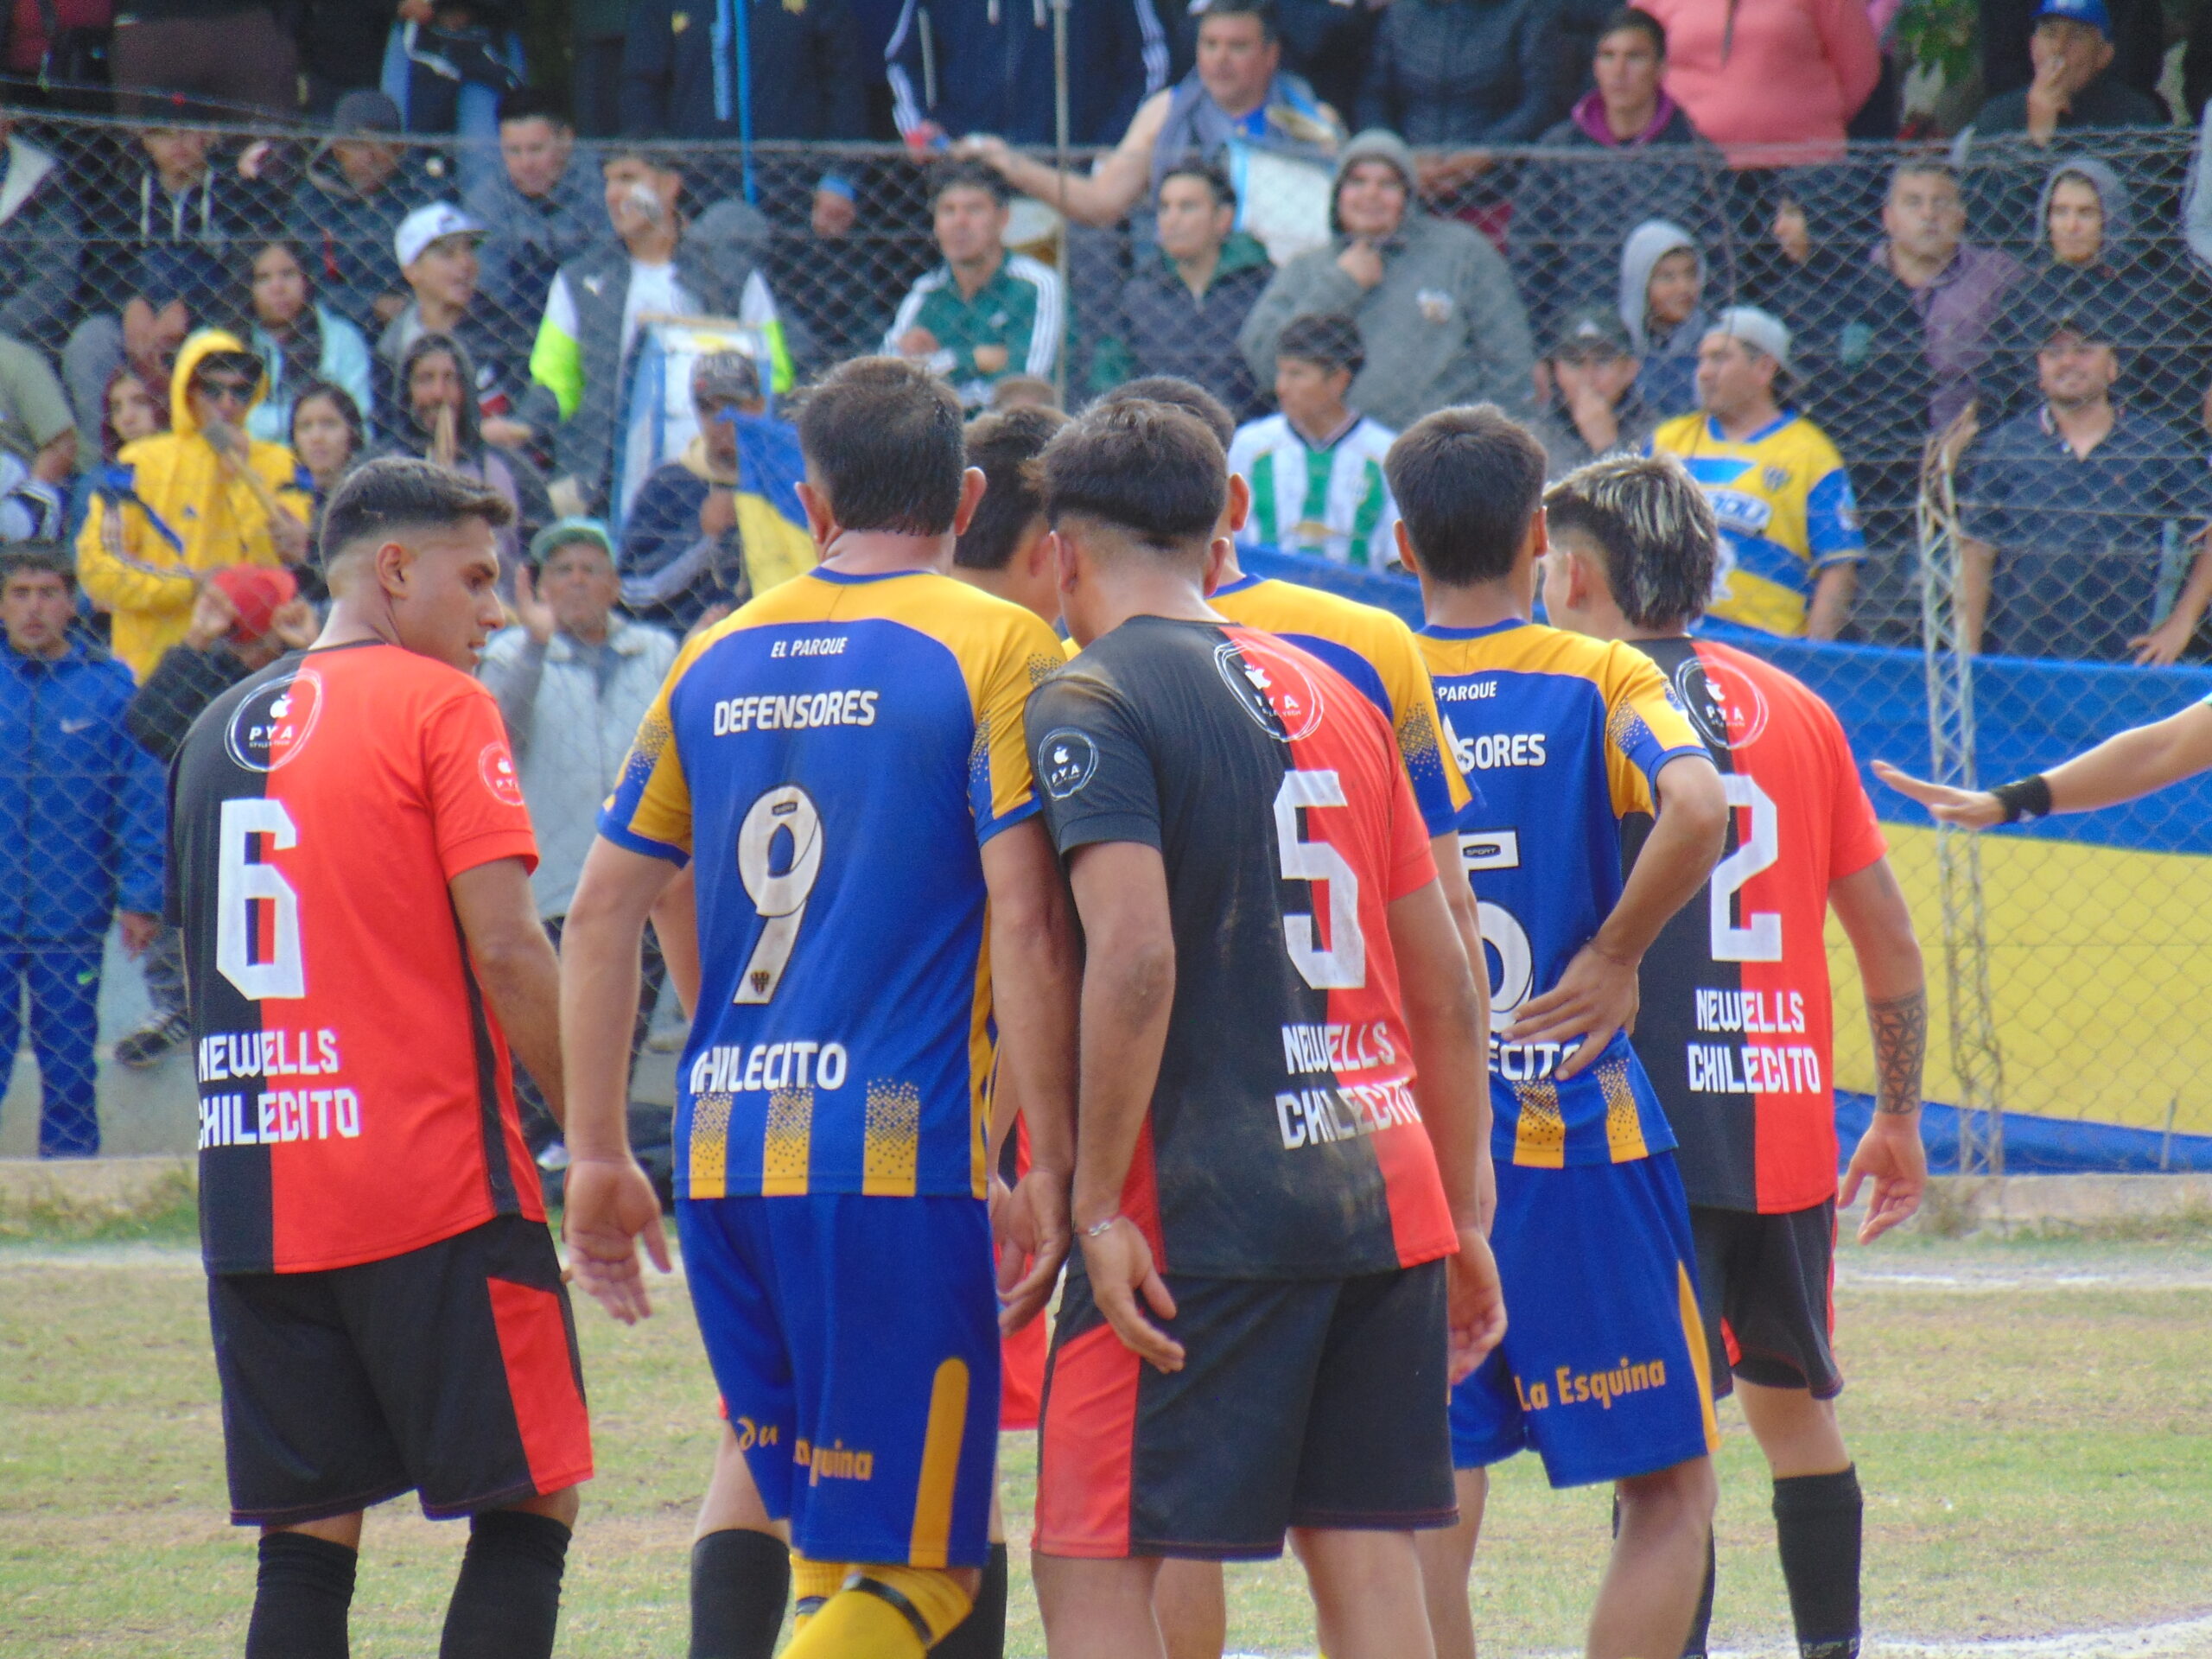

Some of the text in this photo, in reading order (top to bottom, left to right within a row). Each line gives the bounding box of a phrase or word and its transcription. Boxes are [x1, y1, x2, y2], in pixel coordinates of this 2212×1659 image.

[771, 637, 849, 658] EL PARQUE
[713, 690, 880, 737] DEFENSORES
[1438, 681, 1497, 702] PARQUE
[249, 725, 293, 741] PYA
[1457, 734, 1547, 771] SORES
[495, 779, 519, 789] PY
[1273, 769, 1366, 989] 5
[1710, 773, 1783, 962] 2
[216, 798, 306, 1001] 6
[733, 785, 823, 1004] 9
[1695, 988, 1806, 1033] NEWELLS
[198, 1029, 340, 1084] NEWELLS
[1281, 1021, 1396, 1075] NEWELLS
[1688, 1044, 1821, 1094] CHILECITO
[1514, 1357, 1666, 1412] La Esquina
